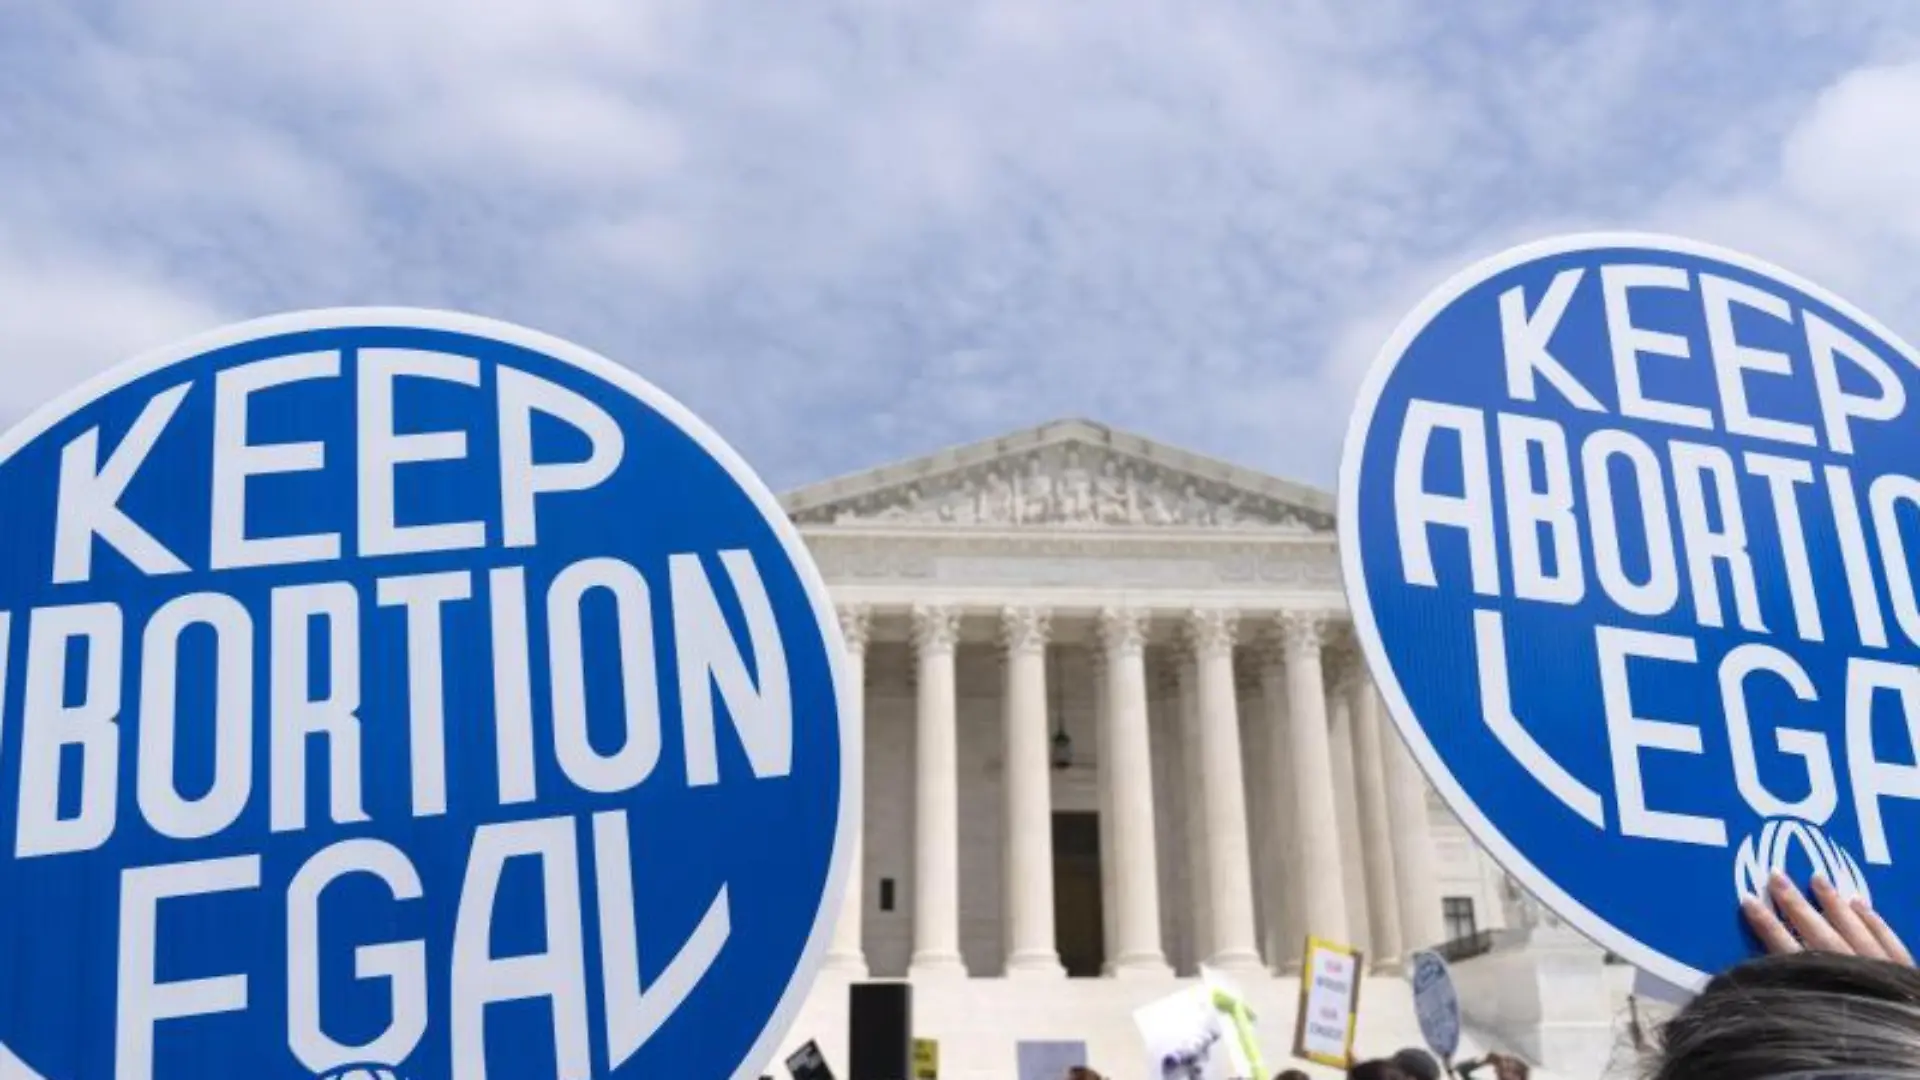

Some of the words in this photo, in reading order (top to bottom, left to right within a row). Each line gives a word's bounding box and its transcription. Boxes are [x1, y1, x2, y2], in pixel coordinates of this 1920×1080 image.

[53, 348, 623, 583] KEEP
[1500, 264, 1906, 454] KEEP
[0, 550, 791, 857] BORTION
[1474, 610, 1920, 863] LEGA
